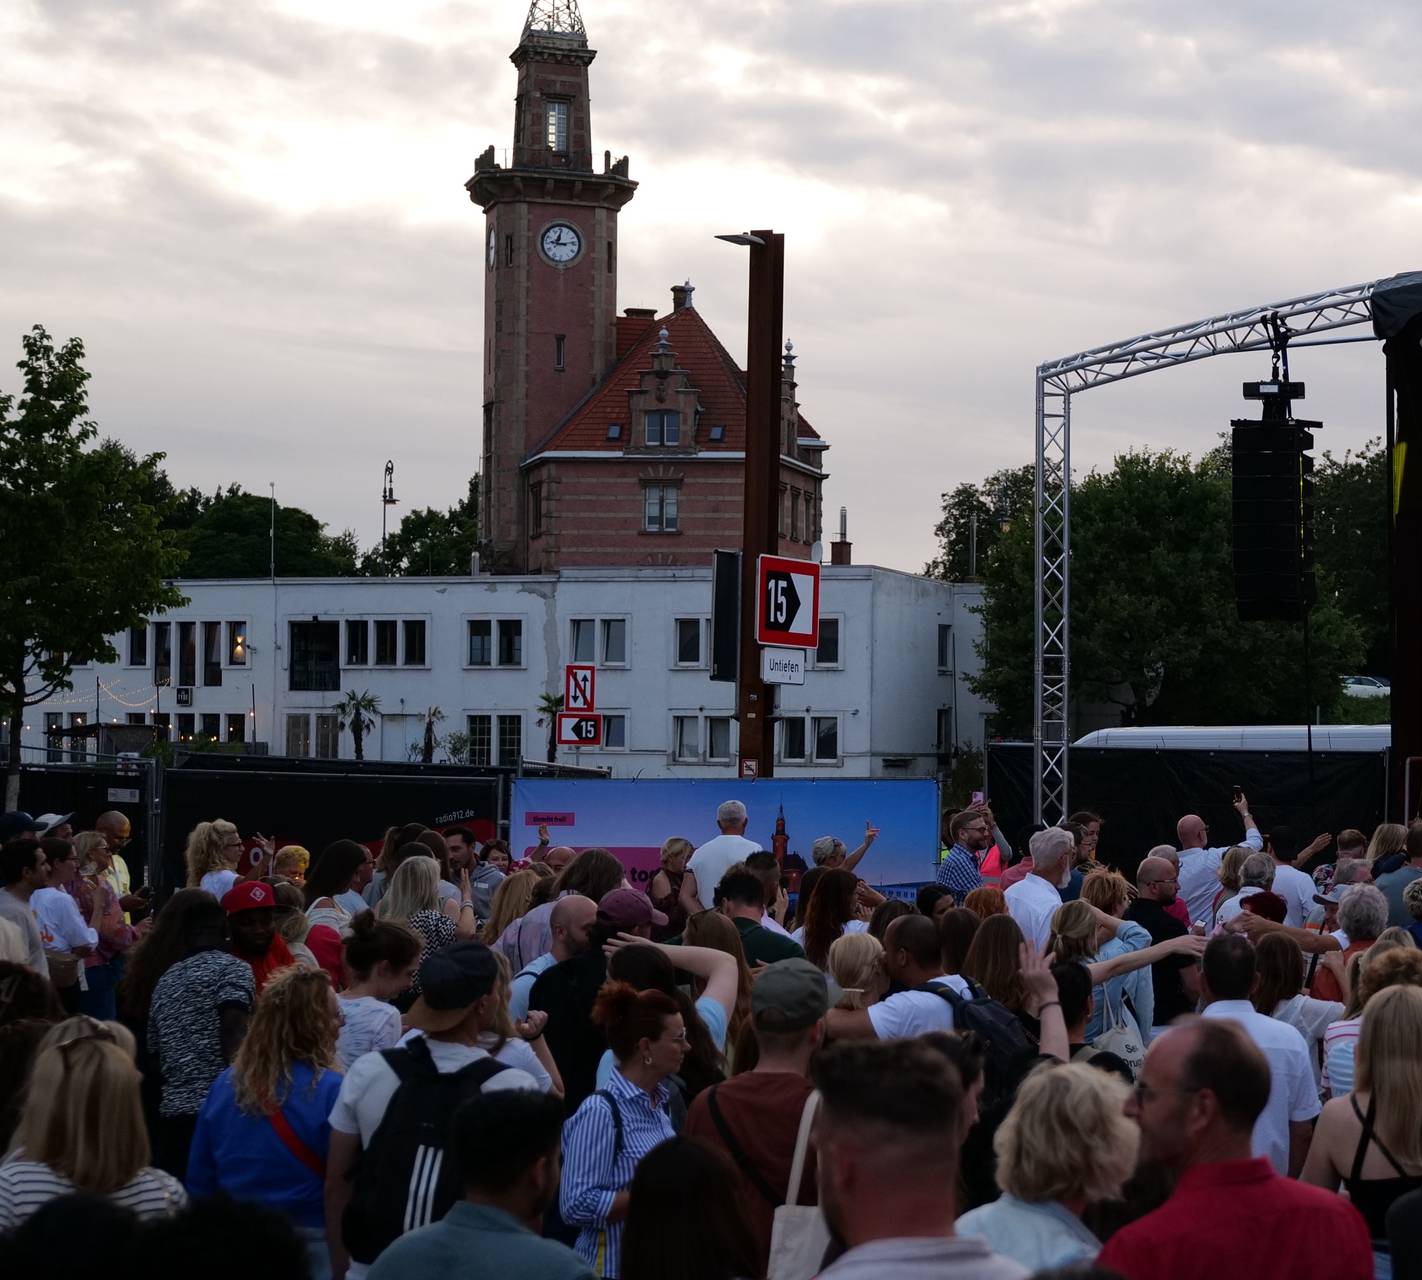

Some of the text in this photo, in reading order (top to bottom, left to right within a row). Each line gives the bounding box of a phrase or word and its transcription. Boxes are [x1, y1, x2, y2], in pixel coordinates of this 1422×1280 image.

[768, 579, 788, 624] 15
[769, 658, 799, 673] Untiefen
[580, 721, 596, 738] 15
[434, 809, 476, 824] radio912.de
